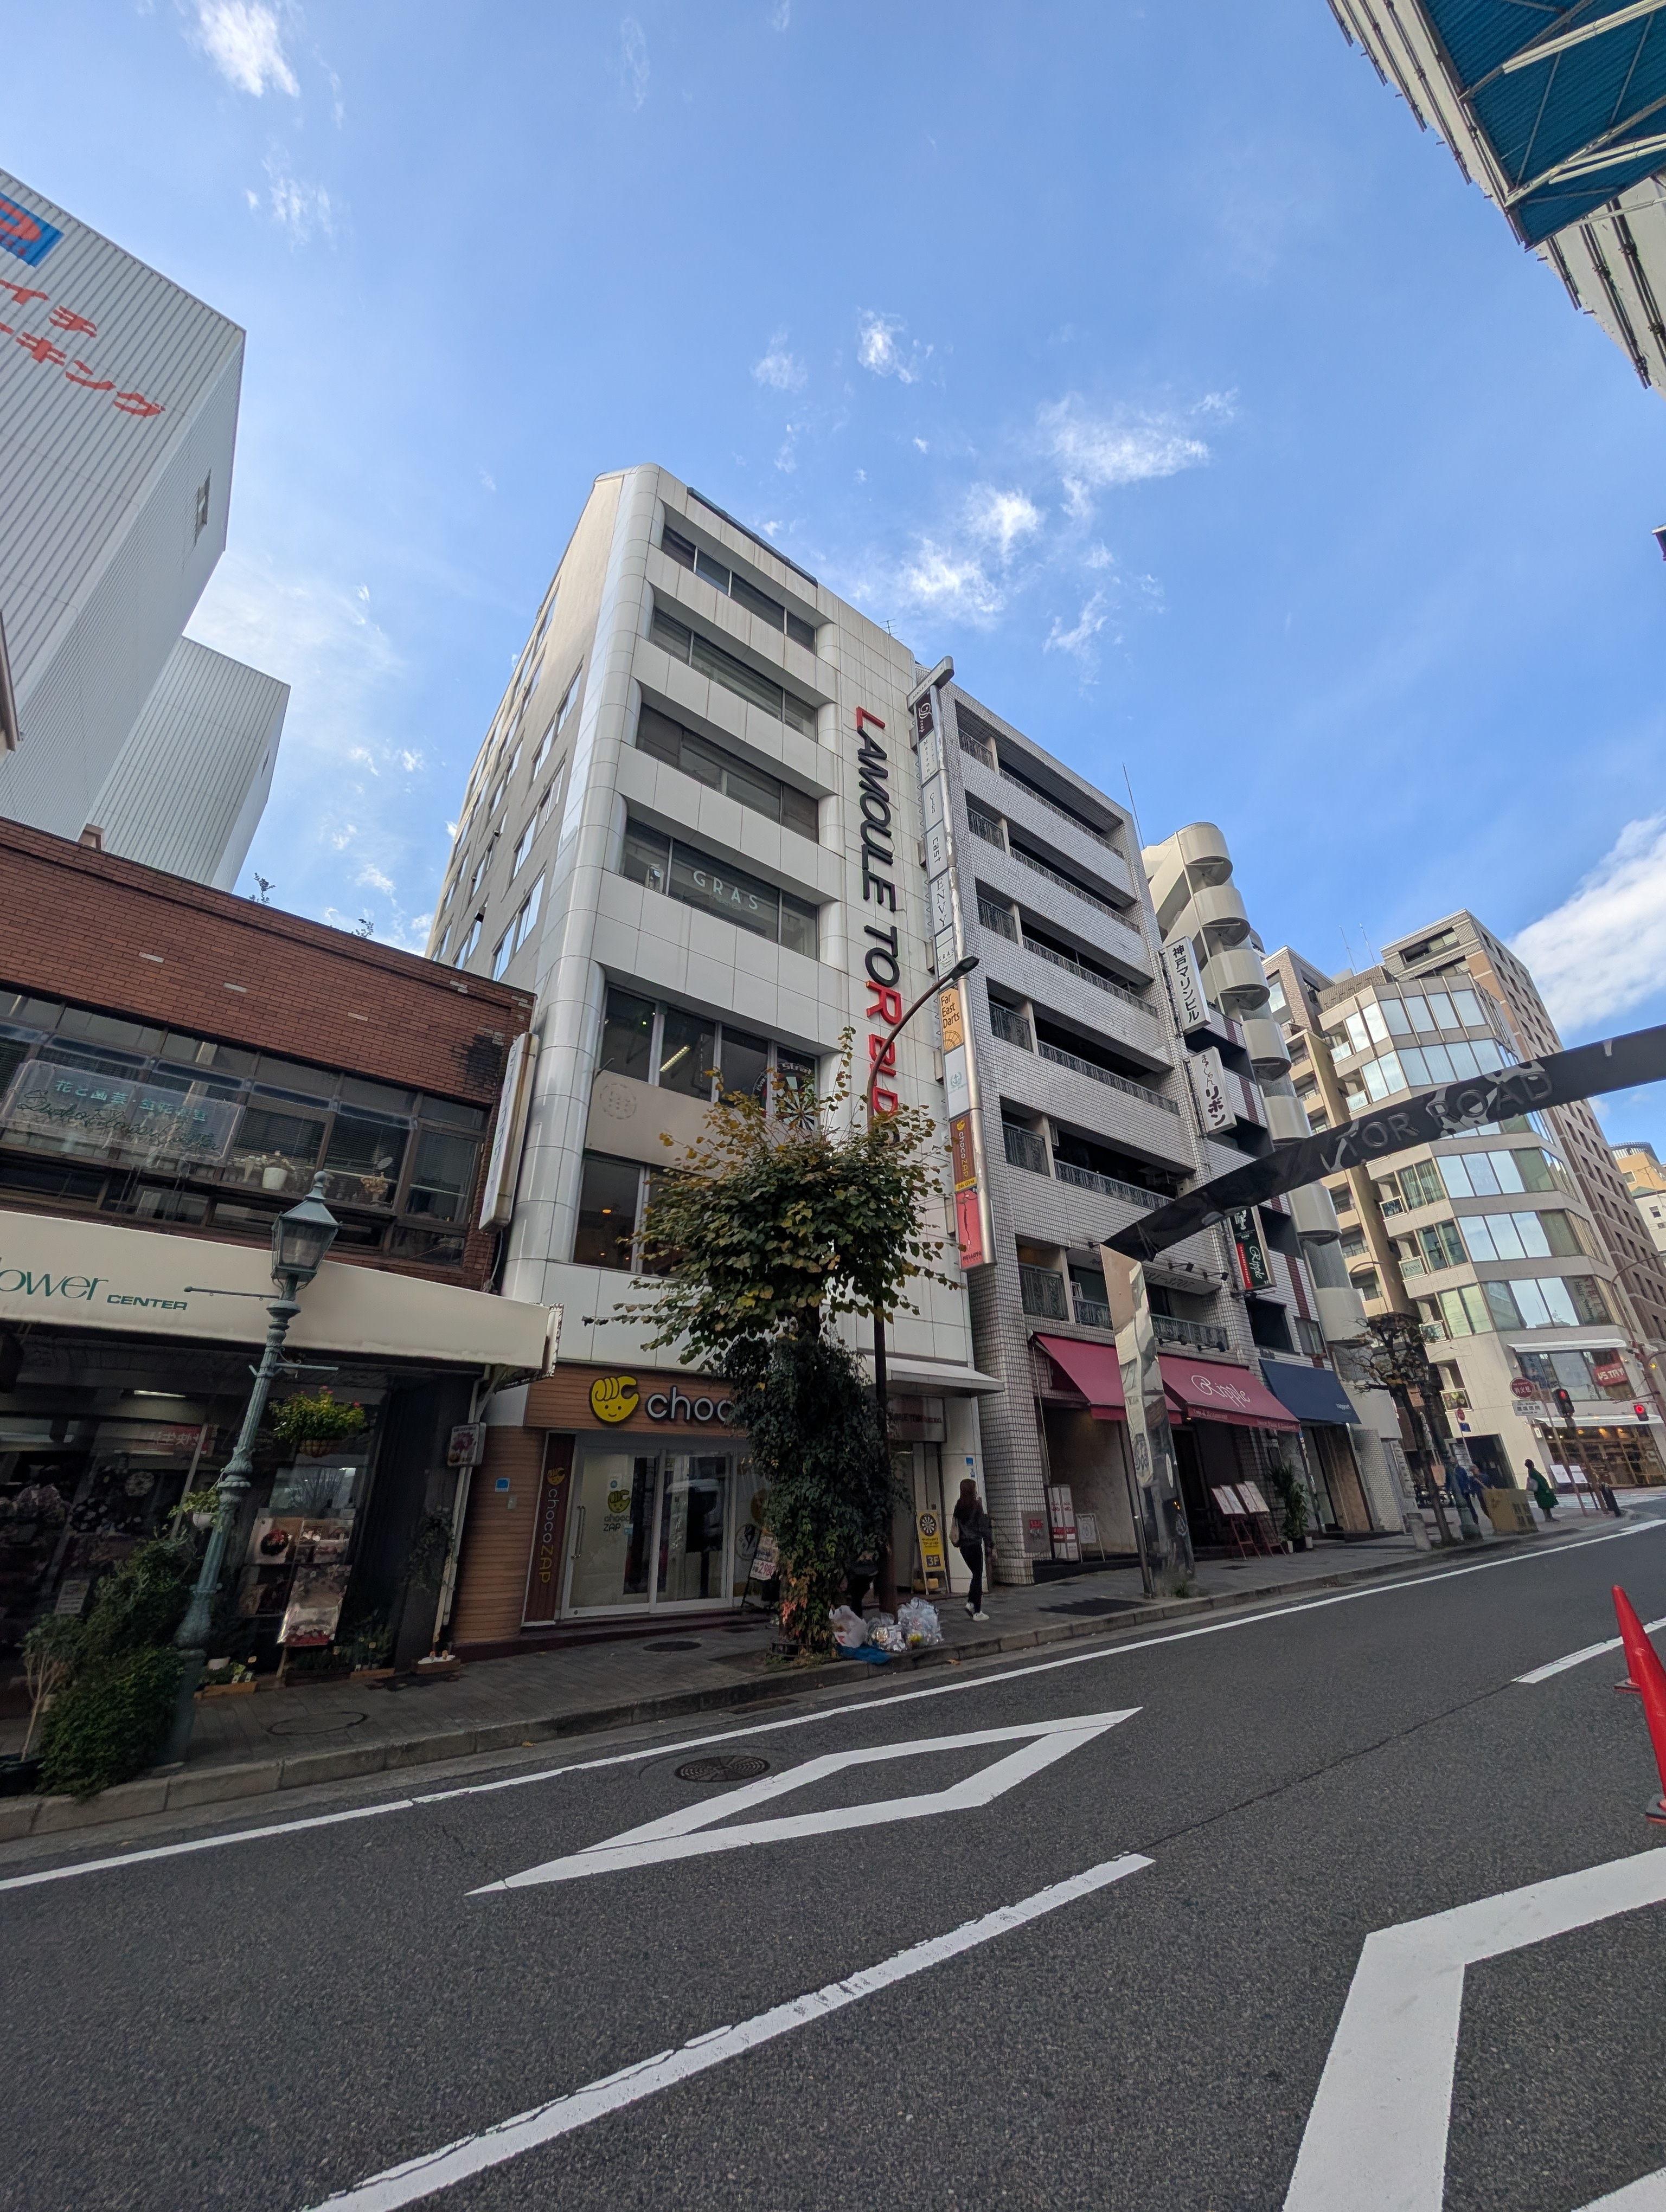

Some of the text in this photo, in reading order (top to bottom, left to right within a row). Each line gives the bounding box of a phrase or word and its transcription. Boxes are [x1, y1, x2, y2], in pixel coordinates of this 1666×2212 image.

[0, 323, 166, 417] キング
[693, 870, 759, 910] GRAS
[936, 878, 947, 928] ENVY
[938, 948, 955, 962] GRAS
[941, 993, 952, 1007] Far
[1172, 944, 1200, 1023] 神戸マリンビル
[941, 1001, 956, 1018] East
[943, 1012, 960, 1030] Darts
[1335, 1071, 1553, 1157] TOR ROAD
[0, 1257, 188, 1311] ower CENTER
[1191, 1374, 1251, 1408] Ripple
[539, 1488, 560, 1584] chocoZAP
[603, 1523, 621, 1532] ZAP
[927, 1556, 939, 1566] 3F
